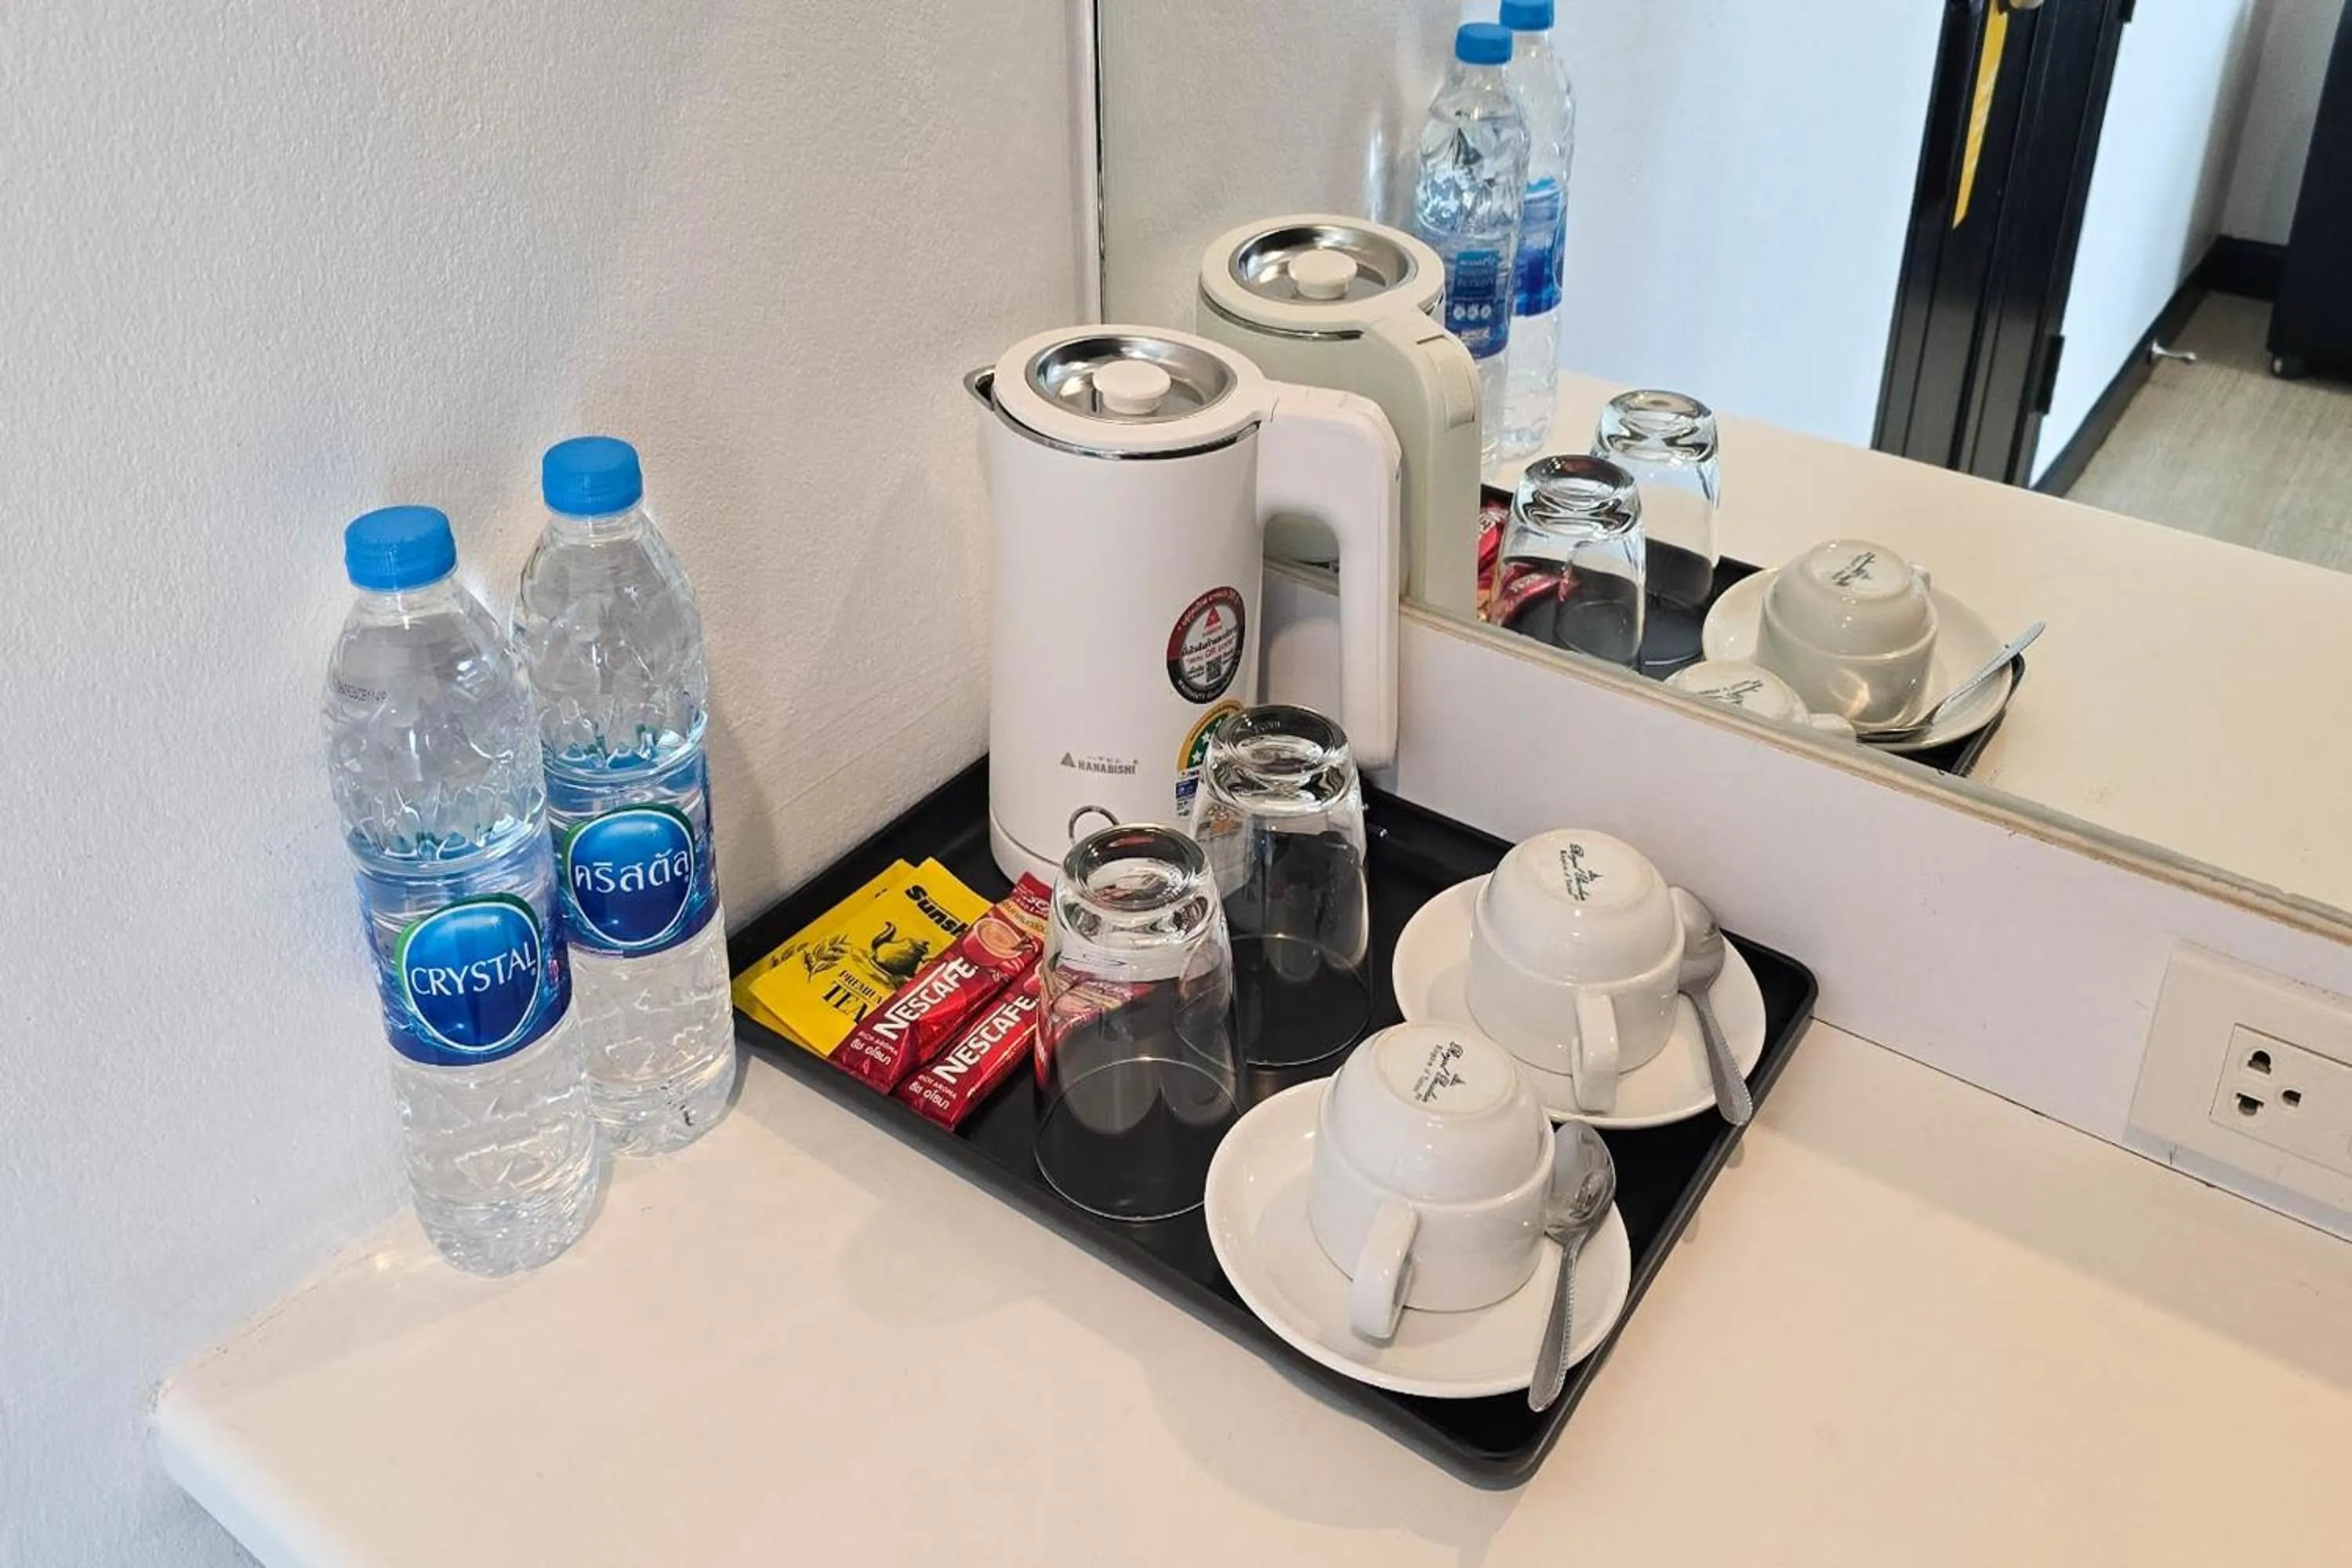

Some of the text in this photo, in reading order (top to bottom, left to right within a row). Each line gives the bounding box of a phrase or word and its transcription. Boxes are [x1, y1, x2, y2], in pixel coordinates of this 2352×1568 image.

[574, 849, 689, 894] คริสตัล
[411, 942, 536, 996] CRYSTAL
[822, 982, 869, 1023] TEA
